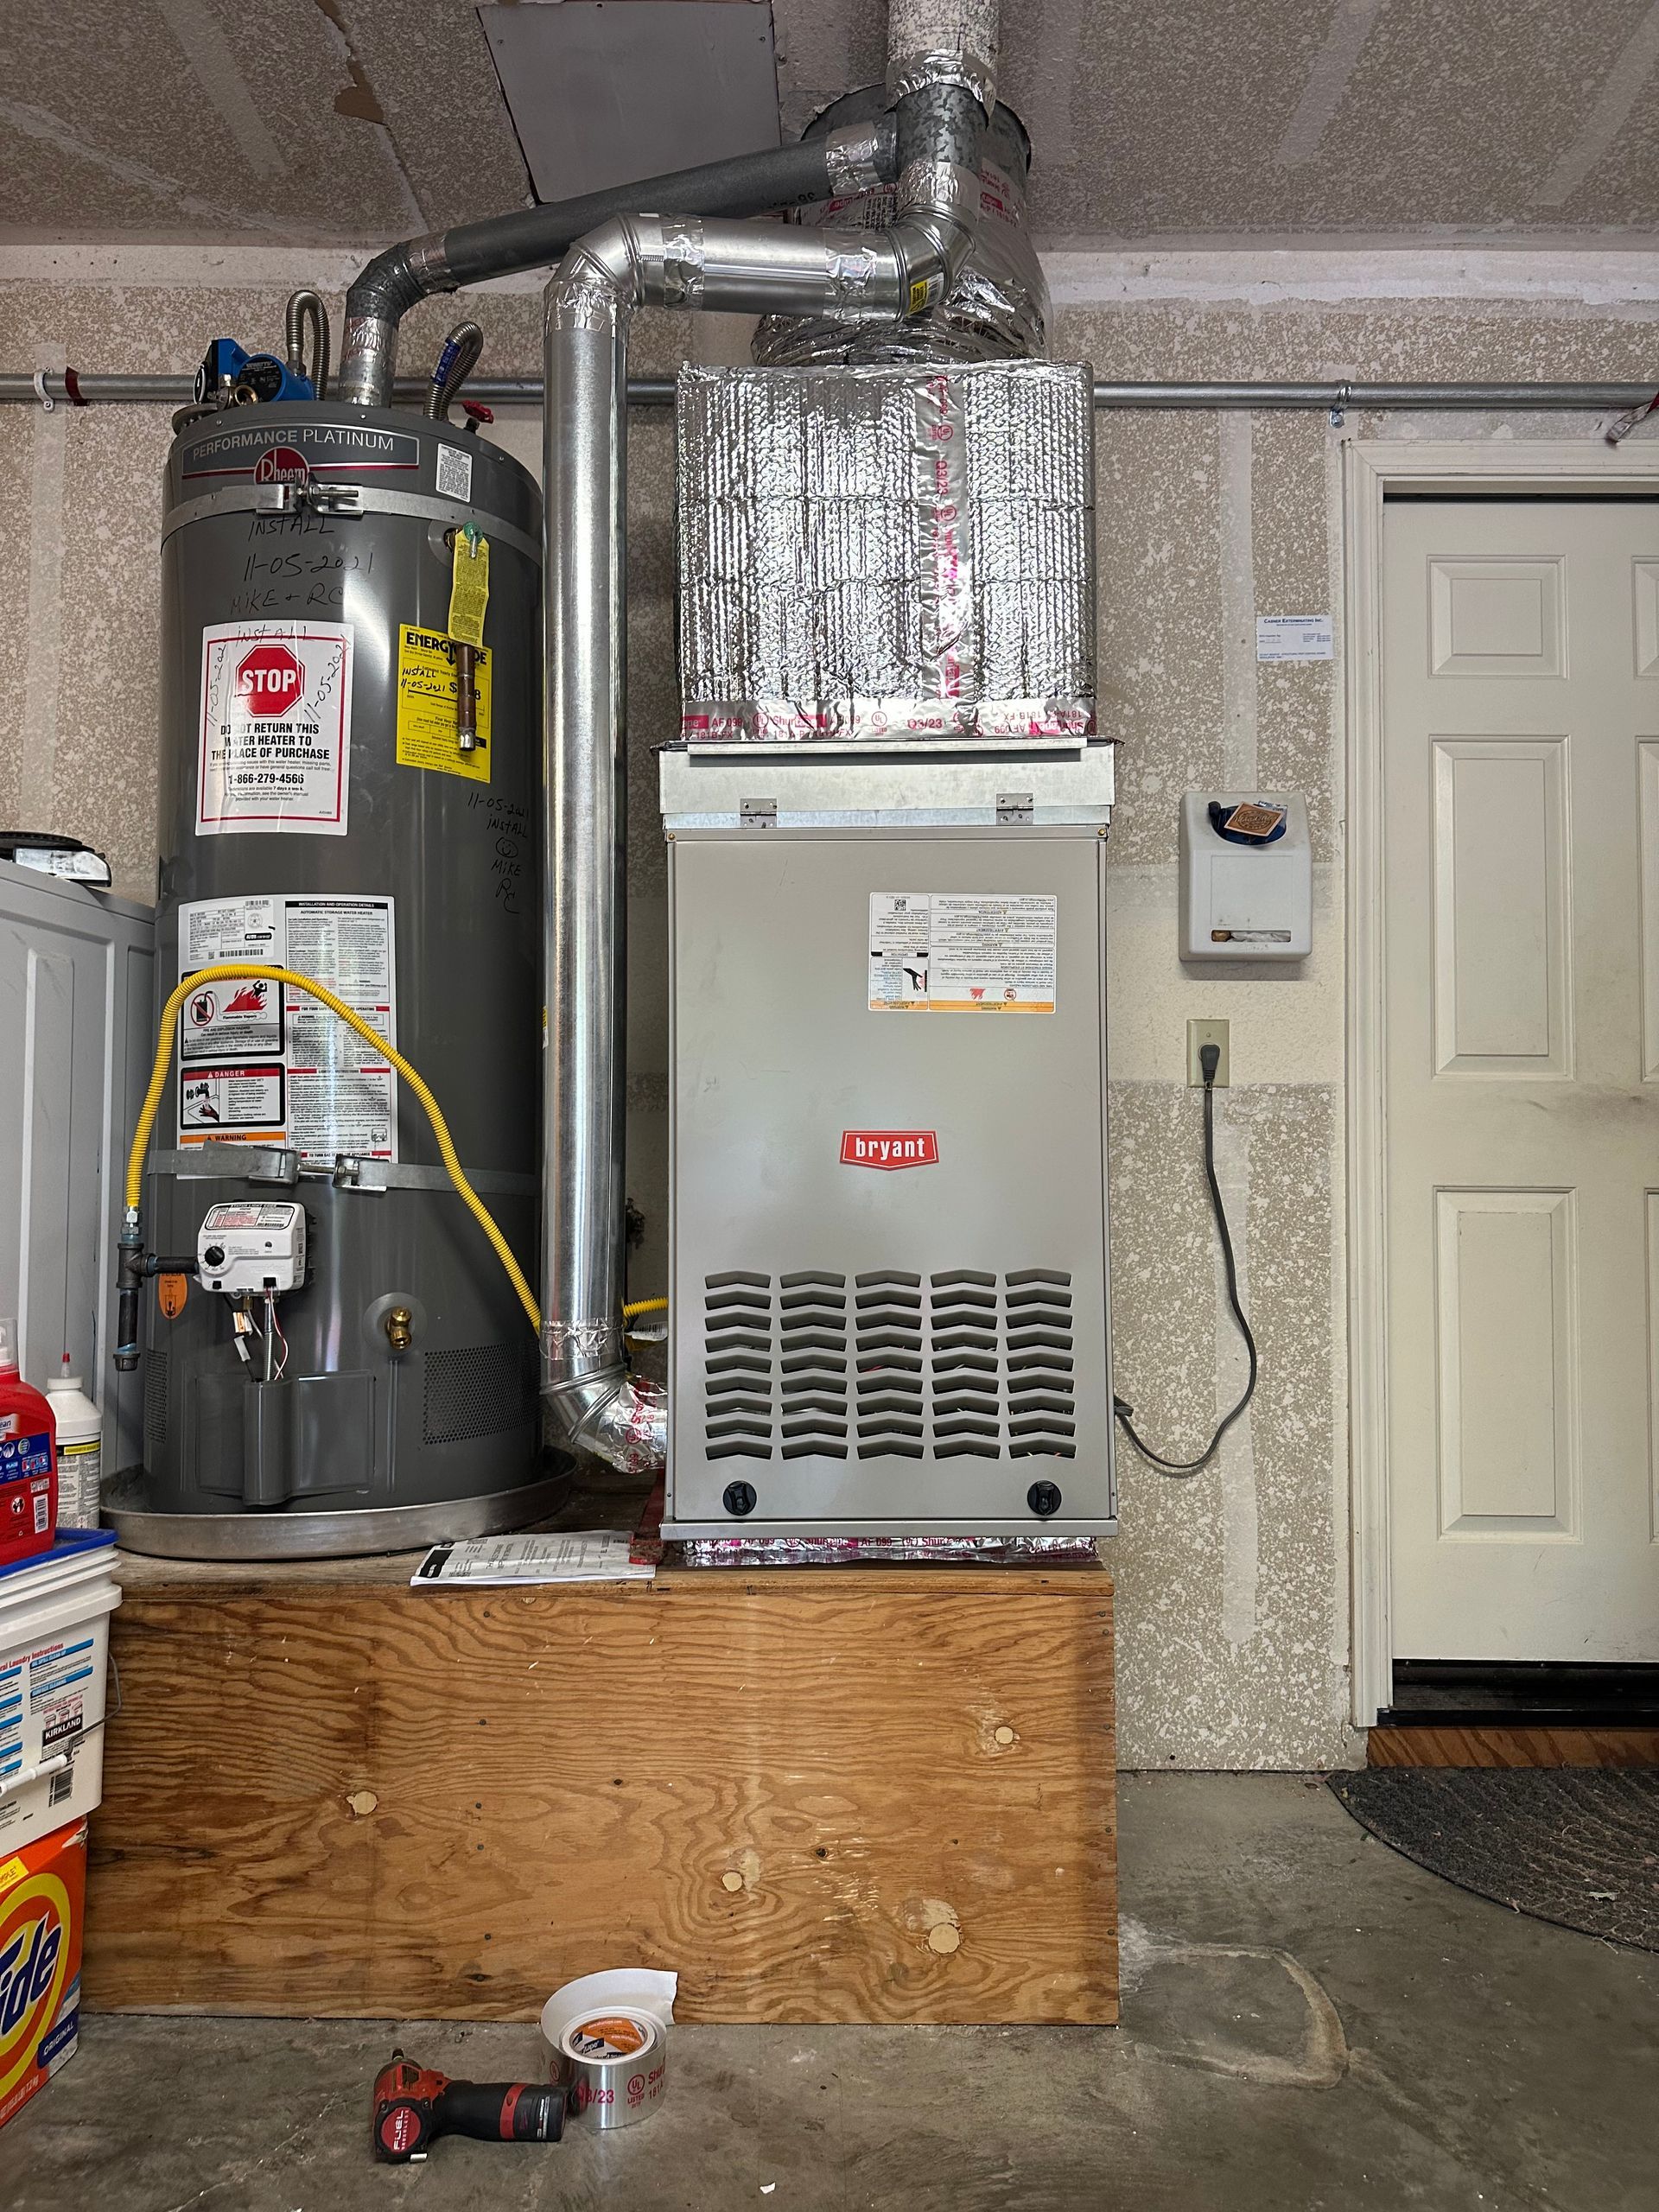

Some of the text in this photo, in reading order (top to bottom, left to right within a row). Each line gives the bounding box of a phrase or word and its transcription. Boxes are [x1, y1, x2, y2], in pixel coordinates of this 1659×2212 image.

[193, 429, 394, 461] PERFORMANCE PLATINUM
[261, 448, 306, 482] Rheem
[242, 668, 297, 693] STOP
[254, 723, 293, 734] RETURN
[296, 723, 320, 734] THIS
[712, 717, 727, 728] AF
[907, 718, 943, 730] Q3/23
[257, 735, 296, 746] HEATER
[298, 735, 313, 747] TO
[212, 750, 226, 760] THE
[259, 747, 273, 758] OF
[275, 747, 330, 760] PURCHASE
[228, 773, 305, 784] 1-866-279-4566
[855, 1137, 925, 1160] bryant
[10, 1643, 64, 1669] Laundry Instructions
[45, 1717, 81, 1739] KIRKLAND
[43, 2021, 74, 2056] ORIGINAL
[627, 2094, 645, 2104] LISTED
[393, 2110, 404, 2151] FUEL
